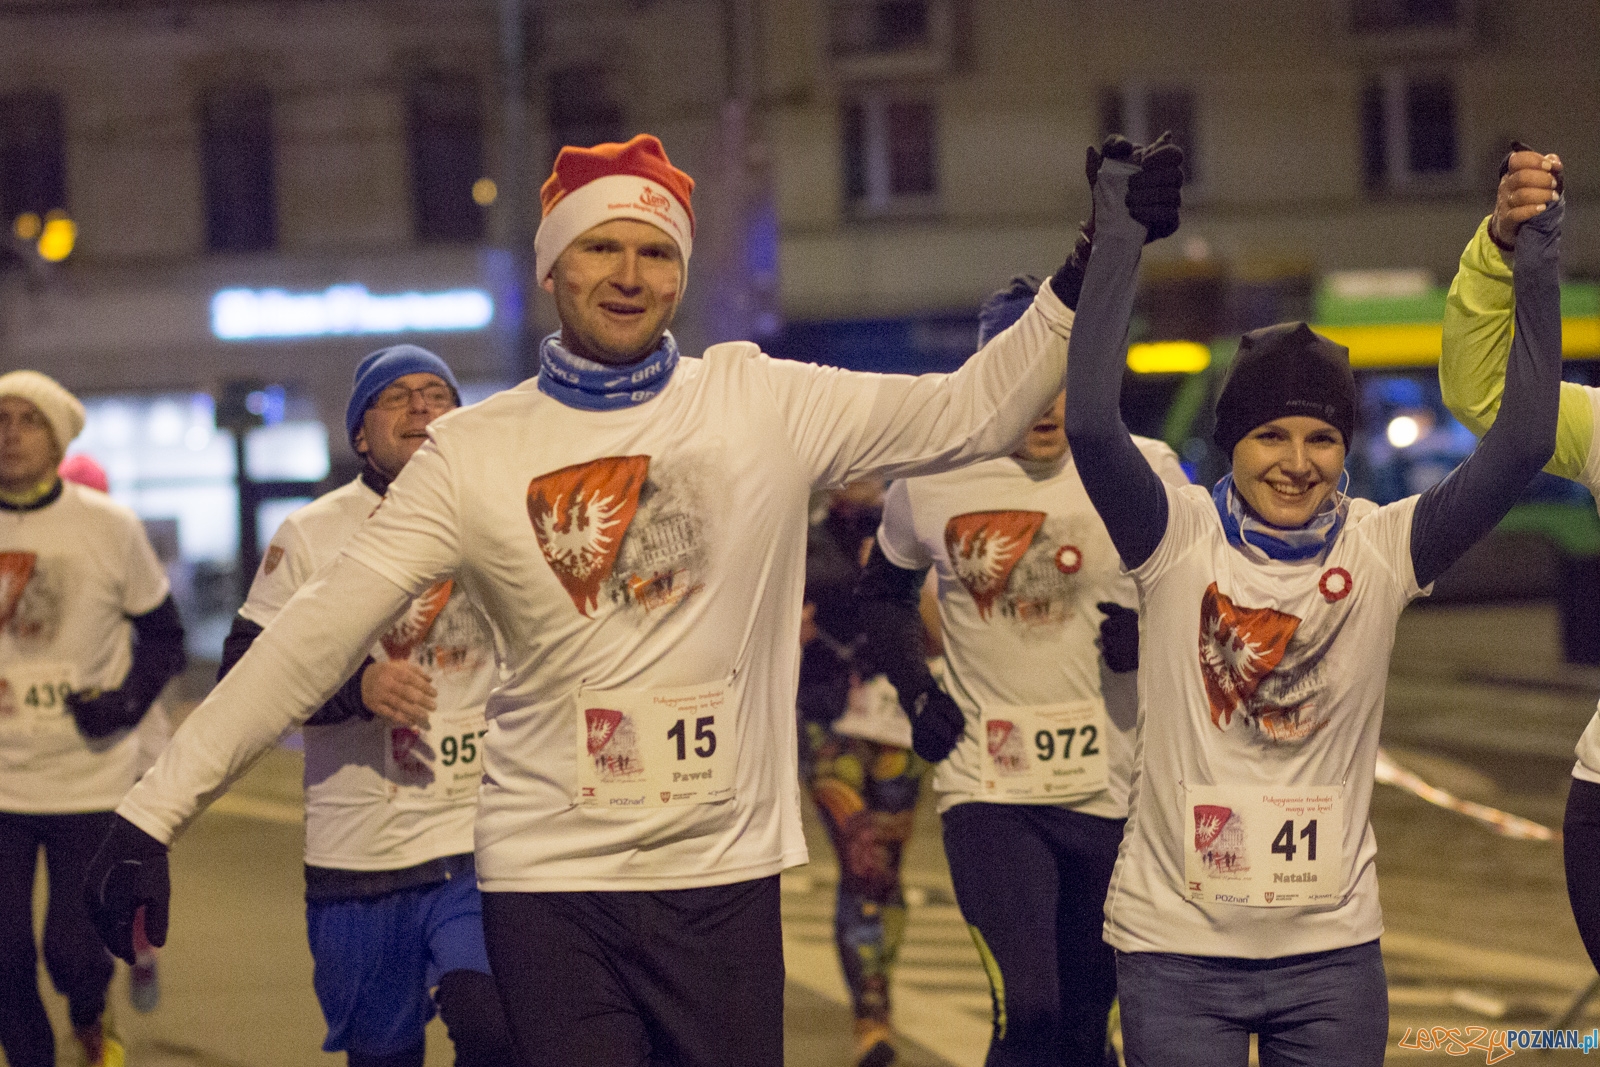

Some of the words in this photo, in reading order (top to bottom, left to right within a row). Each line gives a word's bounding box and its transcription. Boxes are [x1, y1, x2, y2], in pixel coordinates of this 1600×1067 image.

[667, 715, 717, 761] 15
[1035, 724, 1100, 762] 972
[1271, 819, 1318, 862] 41
[1273, 872, 1318, 884] Natalia
